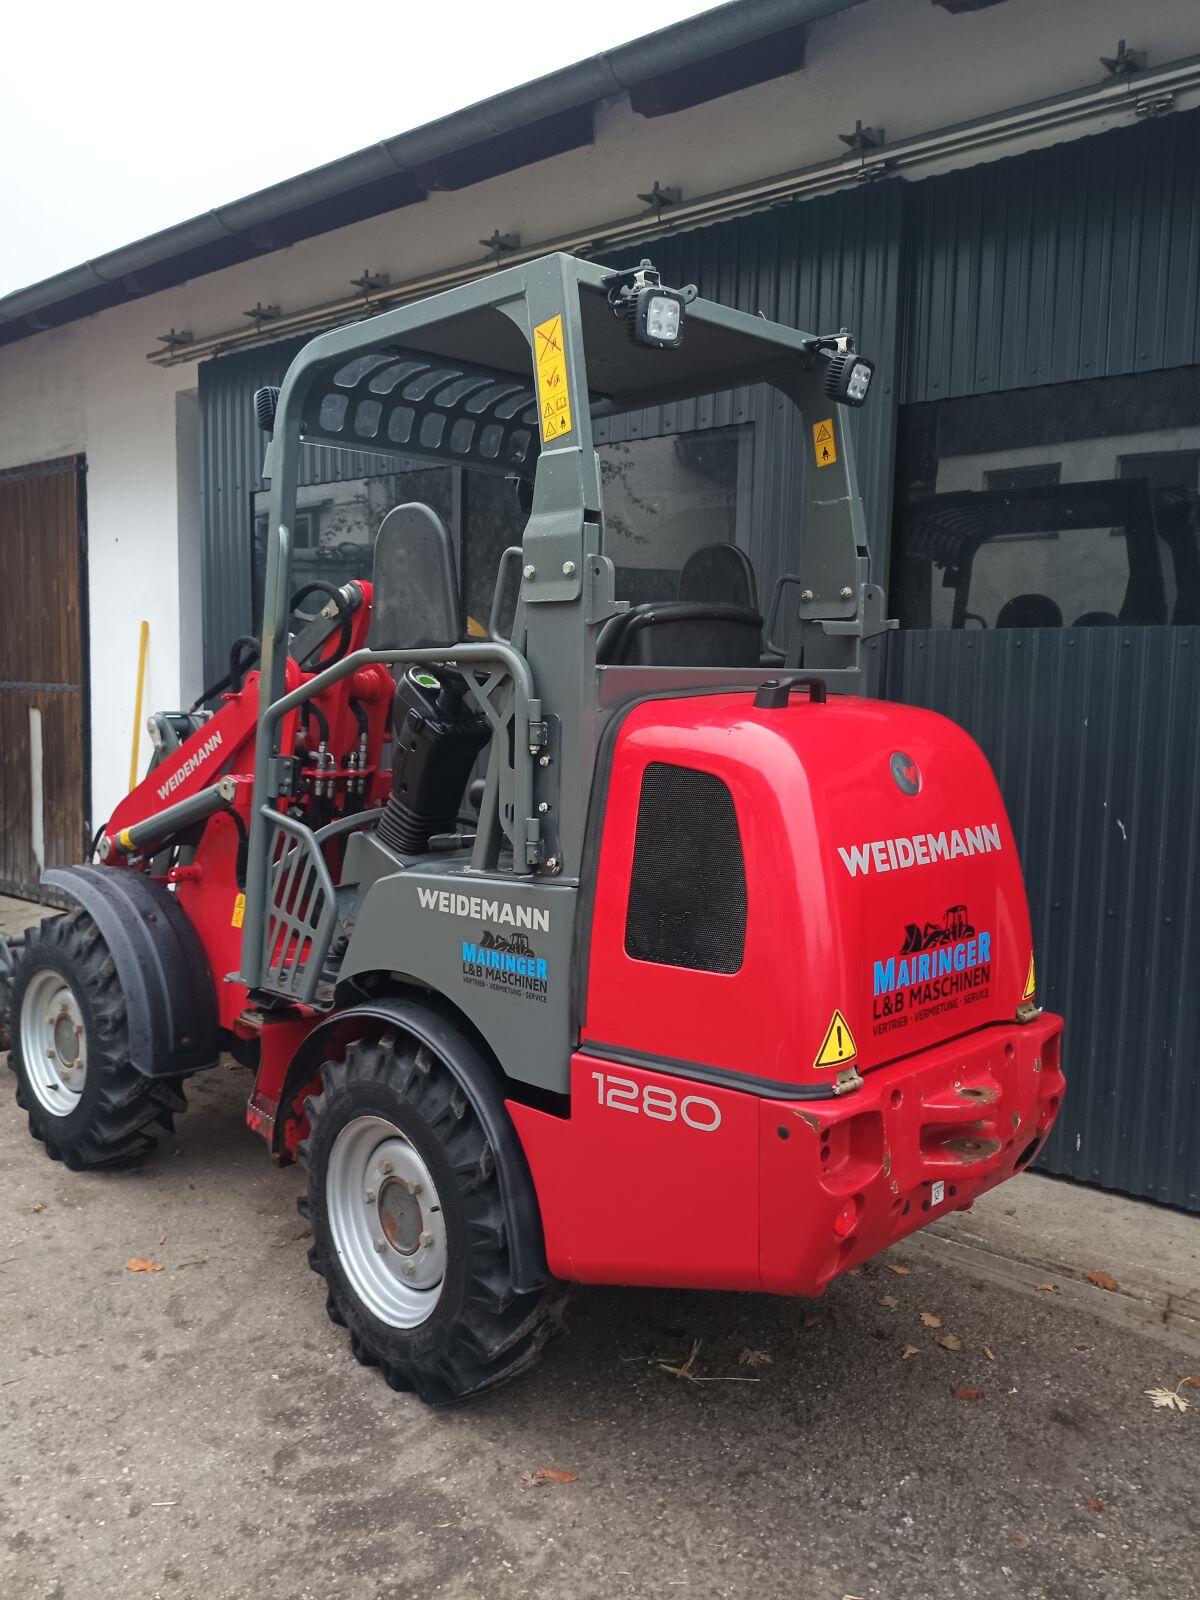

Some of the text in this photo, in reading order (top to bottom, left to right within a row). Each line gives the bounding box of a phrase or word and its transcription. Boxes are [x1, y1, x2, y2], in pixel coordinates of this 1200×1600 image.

[156, 730, 223, 800] WEIDEMANN
[837, 823, 1002, 878] WEIDEMANN
[416, 887, 550, 932] WEIDEMANN
[462, 941, 548, 980] MAIRINGER
[462, 962, 548, 994] L&B MASCHINEN
[873, 931, 991, 997] MAIRINGER
[463, 976, 548, 1004] VERTRIEB VERMIETUNG SERVICE
[872, 987, 991, 1036] VERTRIEB VERMIETUNG SERVICE
[873, 964, 991, 1020] L&B MASCHINEN
[592, 1071, 722, 1132] 1280
